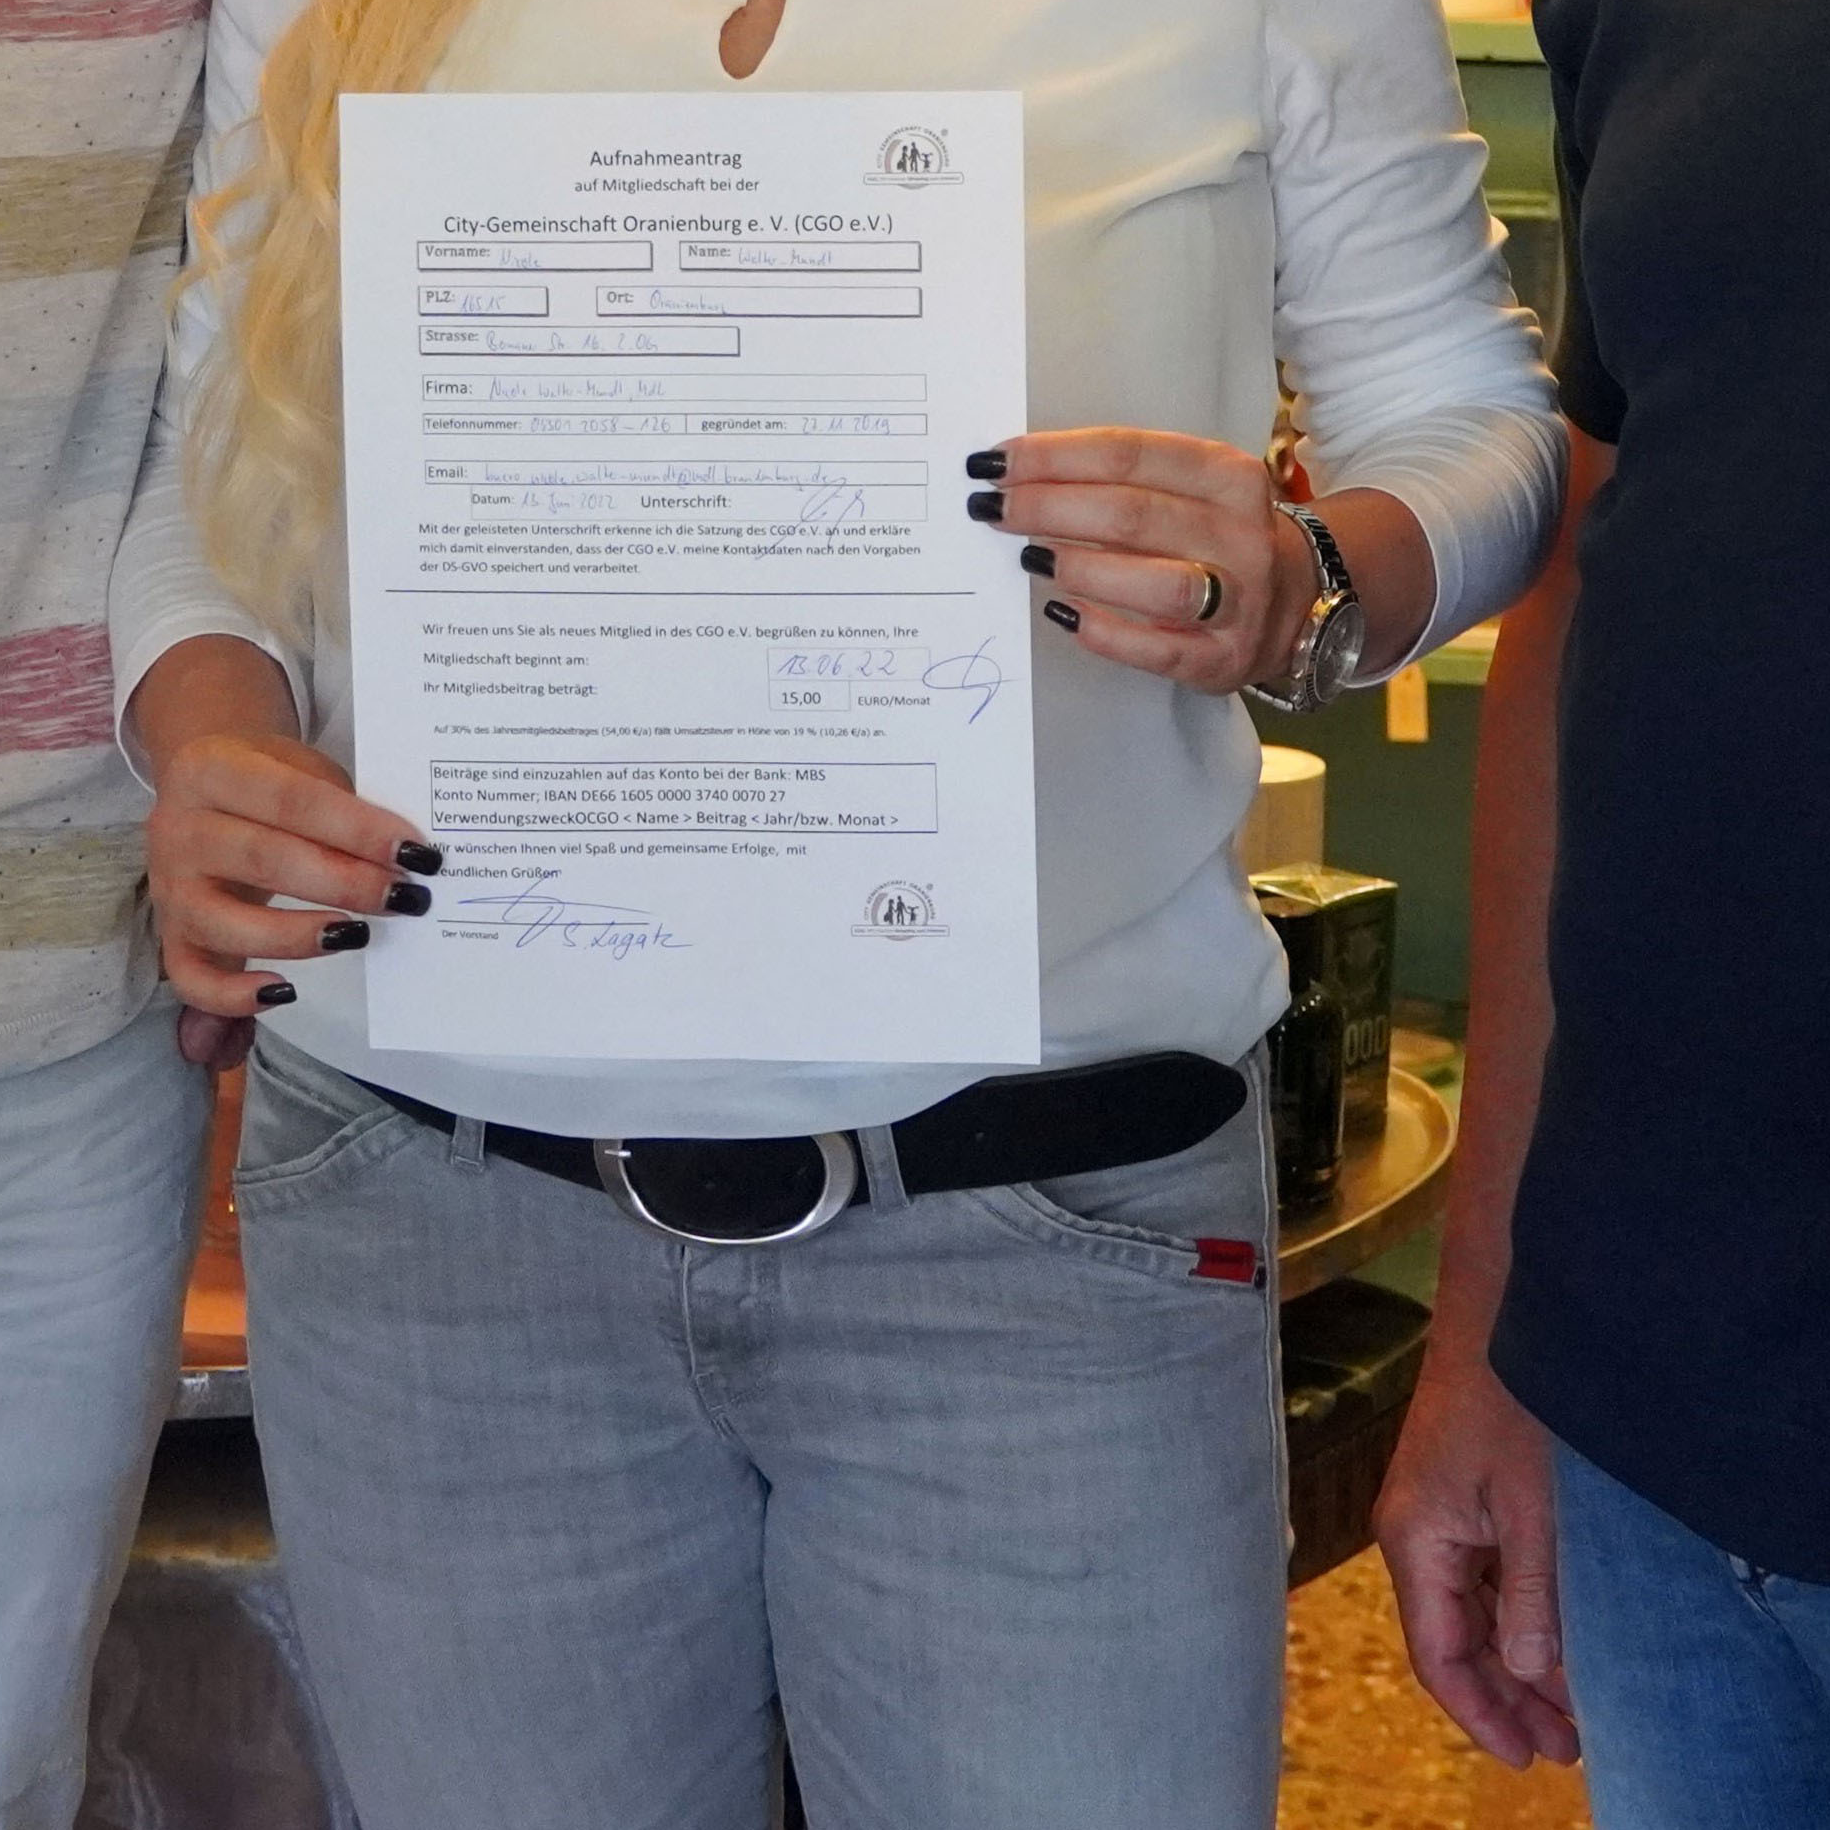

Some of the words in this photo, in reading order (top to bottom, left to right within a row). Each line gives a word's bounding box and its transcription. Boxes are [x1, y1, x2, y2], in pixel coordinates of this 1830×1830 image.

[589, 149, 743, 170] Aufnahmeantrag
[574, 177, 599, 193] auf
[602, 177, 706, 195] Mitgliedschaft
[709, 177, 732, 192] bei
[735, 177, 760, 192] der
[443, 214, 618, 237] City-Gemeinschaft
[622, 213, 743, 236] Oranienburg
[747, 218, 765, 233] e.
[769, 214, 789, 232] V.
[794, 213, 844, 236] (CGO
[849, 213, 893, 235] e.V.)
[425, 244, 490, 258] Vorname:
[687, 245, 731, 258] Name:
[425, 290, 455, 304] PLZ:
[606, 291, 635, 304] Ort:
[425, 329, 479, 343] Strasse:
[425, 380, 474, 395] Firma:
[425, 418, 523, 431] Telefonnummer:
[700, 418, 762, 432] gegründet
[765, 420, 788, 431] am:
[427, 466, 468, 479] Email:
[471, 493, 515, 506] Datum:
[639, 494, 733, 510] Unterschrift:
[418, 523, 439, 535] Mit
[440, 523, 461, 535] der
[463, 523, 529, 537] geleisteten
[531, 523, 602, 536] Unterschrift
[604, 524, 653, 536] erkenne
[655, 524, 673, 536] ich
[675, 523, 695, 536] die
[697, 524, 744, 539] Satzung
[745, 524, 767, 536] des
[798, 524, 822, 537] e.V.
[842, 524, 867, 537] und
[869, 524, 912, 538] erkläre
[419, 542, 447, 554] mich
[449, 543, 484, 554] damit
[486, 543, 573, 556] einverstanden,
[575, 543, 603, 555] dass
[604, 543, 625, 555] der
[626, 543, 655, 555] CGO
[656, 544, 680, 555] e.V.
[682, 544, 720, 556] meine
[722, 543, 803, 557] Kontaktdaten
[805, 544, 835, 557] nach
[837, 543, 861, 556] den
[862, 544, 922, 558] Vorgaben
[419, 560, 439, 572] der
[442, 561, 489, 573] DS-GVO
[490, 561, 545, 575] speichert
[547, 562, 571, 574] und
[572, 562, 638, 574] verarbeitet.
[422, 623, 444, 635] Wir
[447, 623, 489, 636] freuen
[491, 626, 515, 636] uns
[516, 624, 536, 637] Sie
[538, 624, 556, 637] als
[559, 627, 597, 637] neues
[599, 624, 652, 640] Mitglied
[655, 625, 667, 638] in
[669, 625, 693, 638] des
[695, 625, 725, 638] CGO
[727, 626, 752, 638] e.V.
[755, 625, 817, 641] begrüßen
[819, 628, 835, 638] zu
[837, 625, 890, 640] können,
[893, 625, 919, 638] Ihre
[423, 652, 512, 668] Mitgliedschaft
[514, 653, 562, 669] beginnt
[565, 656, 589, 666] am:
[423, 681, 441, 693] Ihr
[443, 682, 546, 698] Mitgliedsbeitrag
[547, 682, 598, 698] beträgt:
[781, 691, 822, 707] 15,00
[857, 695, 931, 708] EURO/Monat
[433, 766, 489, 783] Beiträge
[491, 767, 520, 780] sind
[522, 767, 603, 781] einzuzahlen
[606, 767, 629, 781] auf
[631, 767, 656, 781] das
[658, 767, 700, 780] Konto
[702, 766, 724, 780] bei
[727, 767, 750, 781] der
[753, 767, 792, 781] Bank:
[795, 768, 827, 782] MBS
[433, 788, 474, 802] Konto
[476, 789, 540, 804] Nummer;
[544, 789, 578, 803] IBAN
[581, 789, 617, 803] DE66
[620, 789, 654, 802] 1605
[657, 788, 692, 802] 0000
[695, 788, 729, 802] 3740
[731, 789, 766, 803] 0070
[769, 789, 786, 803] 27
[622, 814, 632, 824] <
[635, 812, 680, 826] Name
[682, 815, 692, 825] >
[695, 811, 748, 829] Beitrag
[750, 815, 760, 825] <
[761, 812, 834, 829] Jahr/bzw.
[837, 814, 886, 827] Monat
[889, 815, 899, 825] >
[453, 842, 518, 855] wünschen
[520, 842, 557, 855] Ihnen
[559, 842, 582, 855] viel
[584, 841, 617, 857] Spaß
[619, 842, 645, 855] und
[647, 843, 729, 857] gemeinsame
[731, 841, 779, 858] Erfolge,
[786, 844, 807, 856] mit
[440, 864, 508, 879] eundlichen
[510, 865, 559, 880] Grüßen
